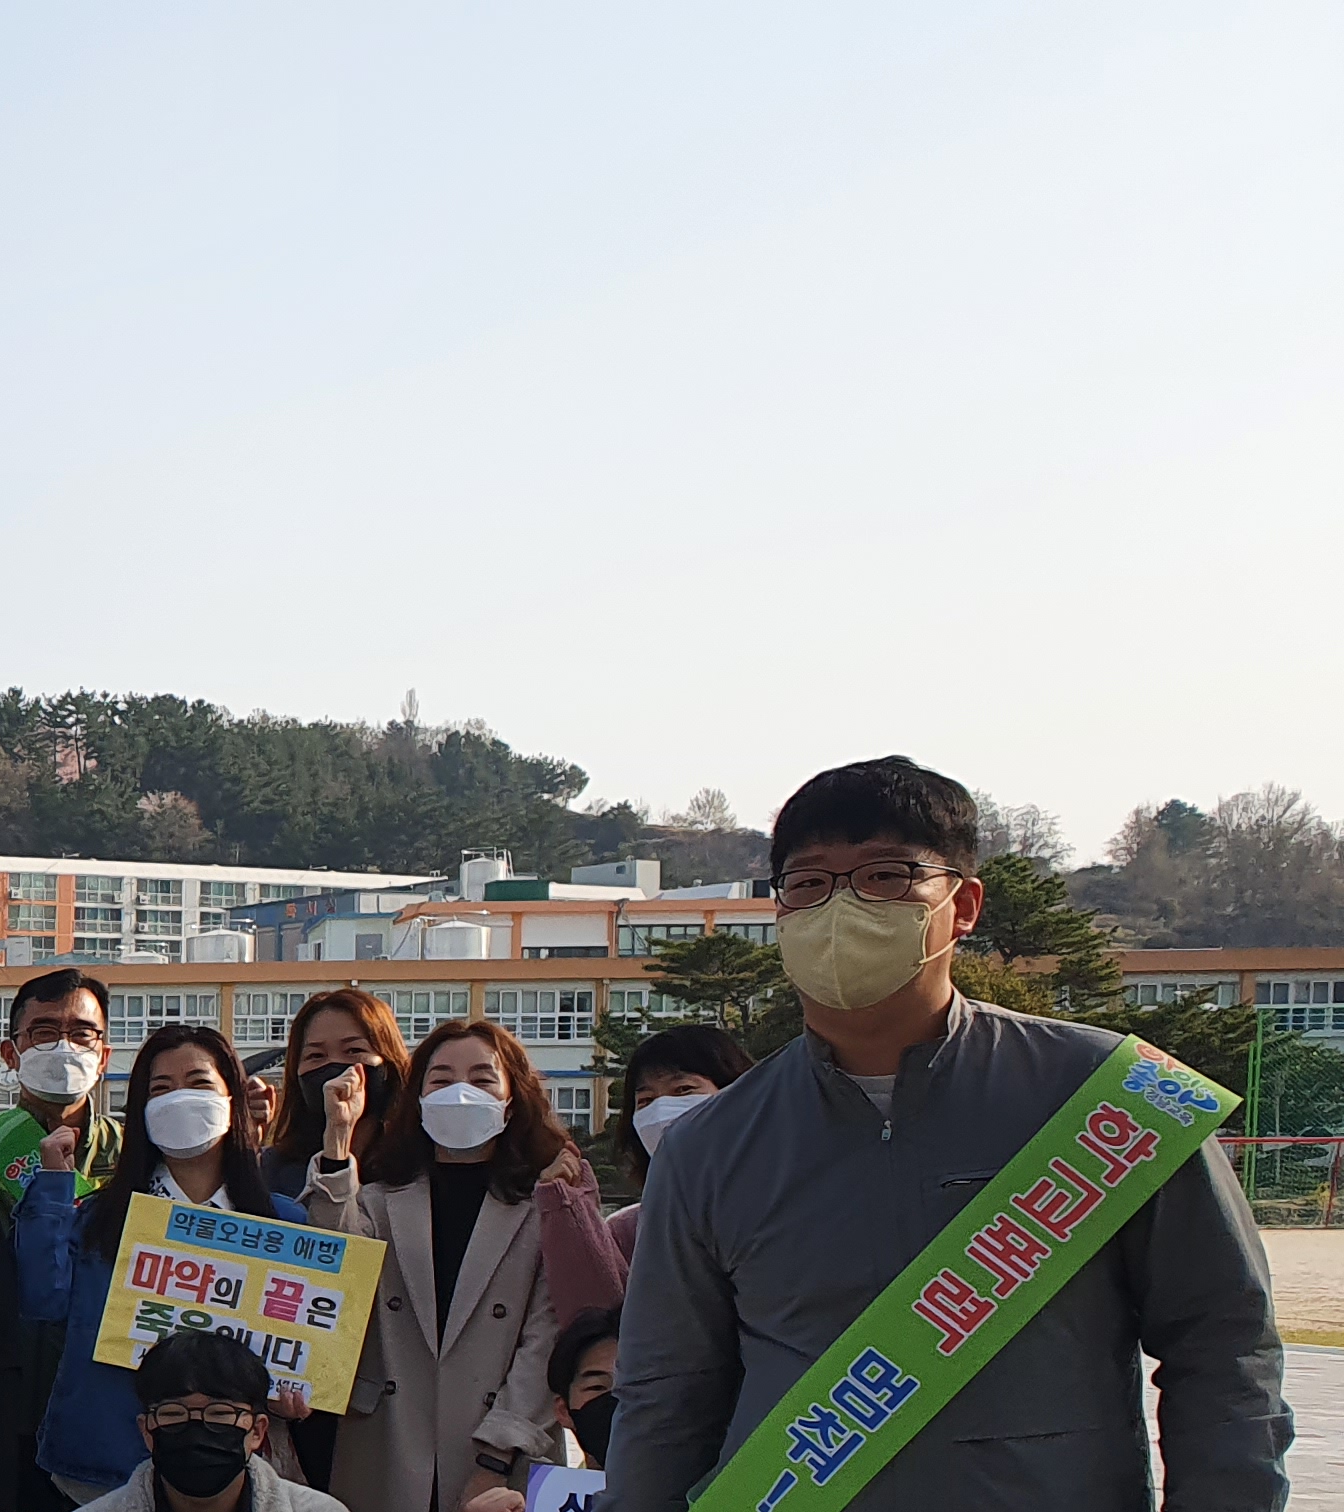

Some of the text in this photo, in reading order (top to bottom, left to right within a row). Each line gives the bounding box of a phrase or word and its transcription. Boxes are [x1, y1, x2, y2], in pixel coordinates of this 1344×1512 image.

[174, 1211, 339, 1265] 약물오남용 예방
[913, 1103, 1160, 1356] 학교폭력
[131, 1251, 337, 1330] 마약의 끝은
